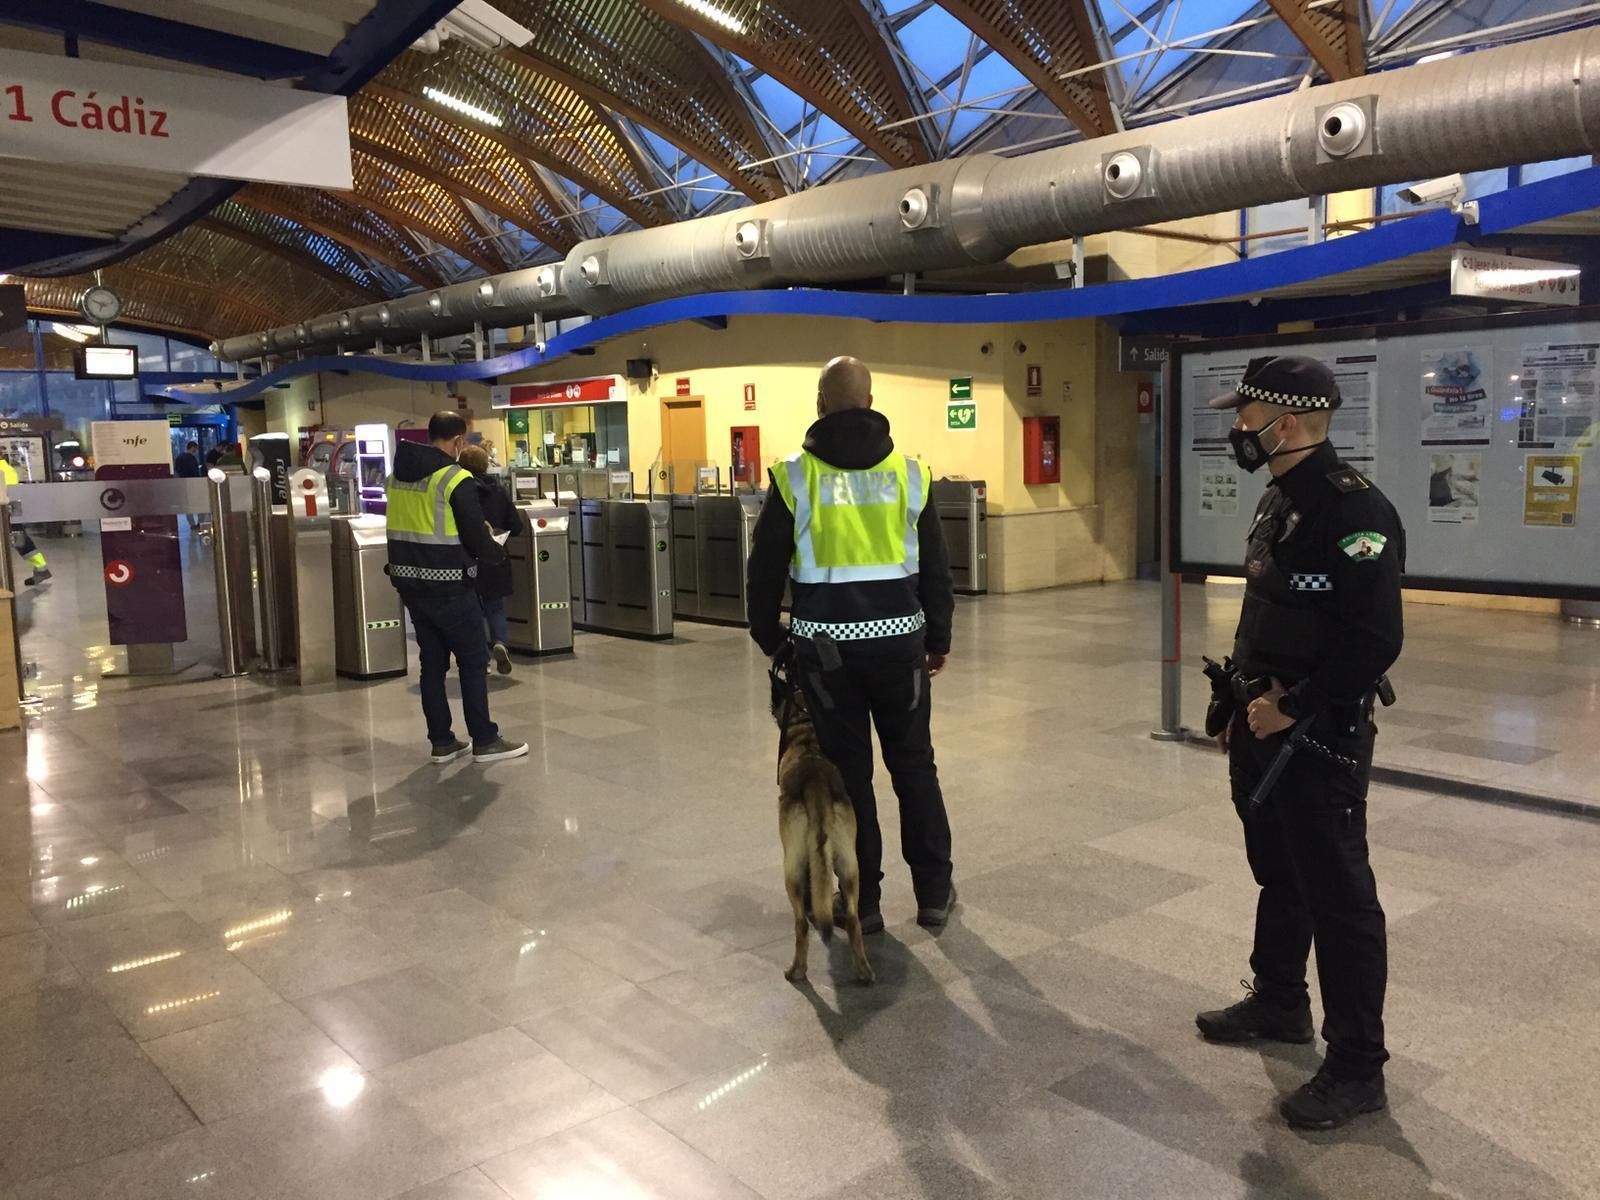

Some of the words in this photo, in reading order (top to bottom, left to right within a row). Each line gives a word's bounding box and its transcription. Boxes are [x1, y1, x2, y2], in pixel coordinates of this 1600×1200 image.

[51, 90, 169, 138] Cádiz
[1144, 347, 1170, 361] Salida
[274, 458, 288, 500] renfe
